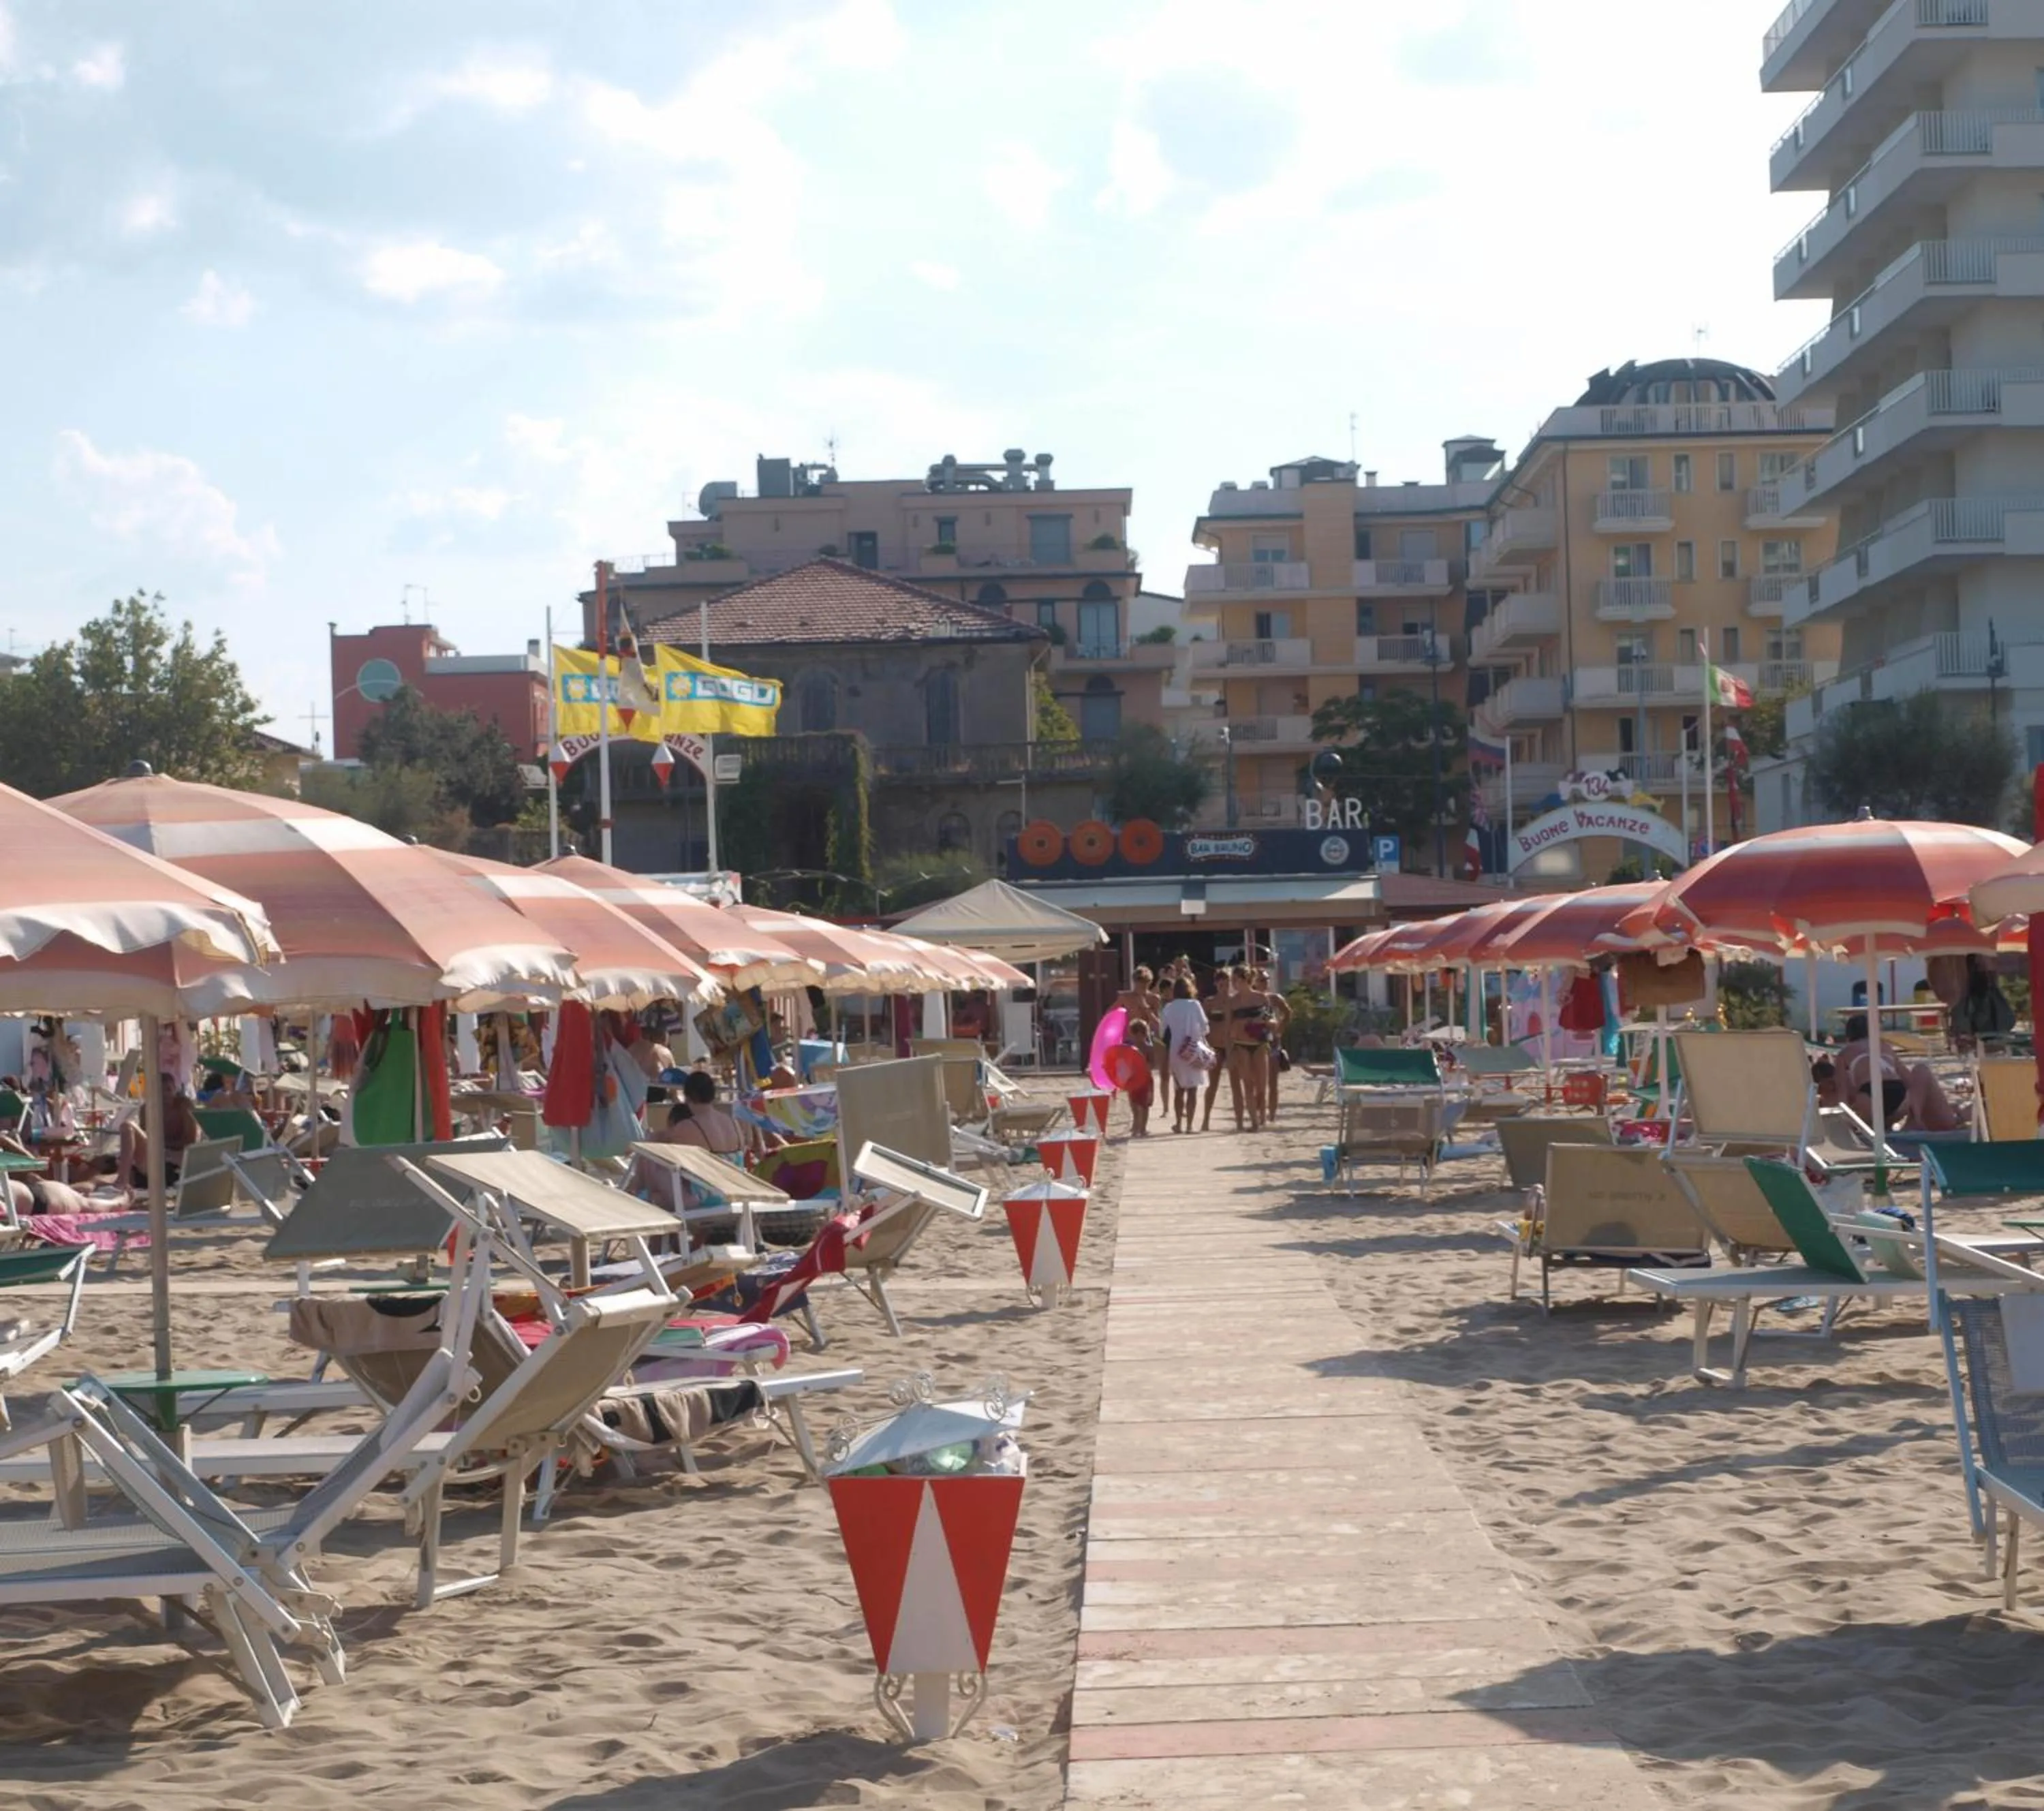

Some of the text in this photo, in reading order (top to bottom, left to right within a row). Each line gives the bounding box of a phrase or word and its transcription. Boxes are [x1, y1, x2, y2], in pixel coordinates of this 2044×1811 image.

[1585, 777, 1609, 796] 134
[1305, 797, 1363, 830] BAR
[1379, 839, 1395, 858] P
